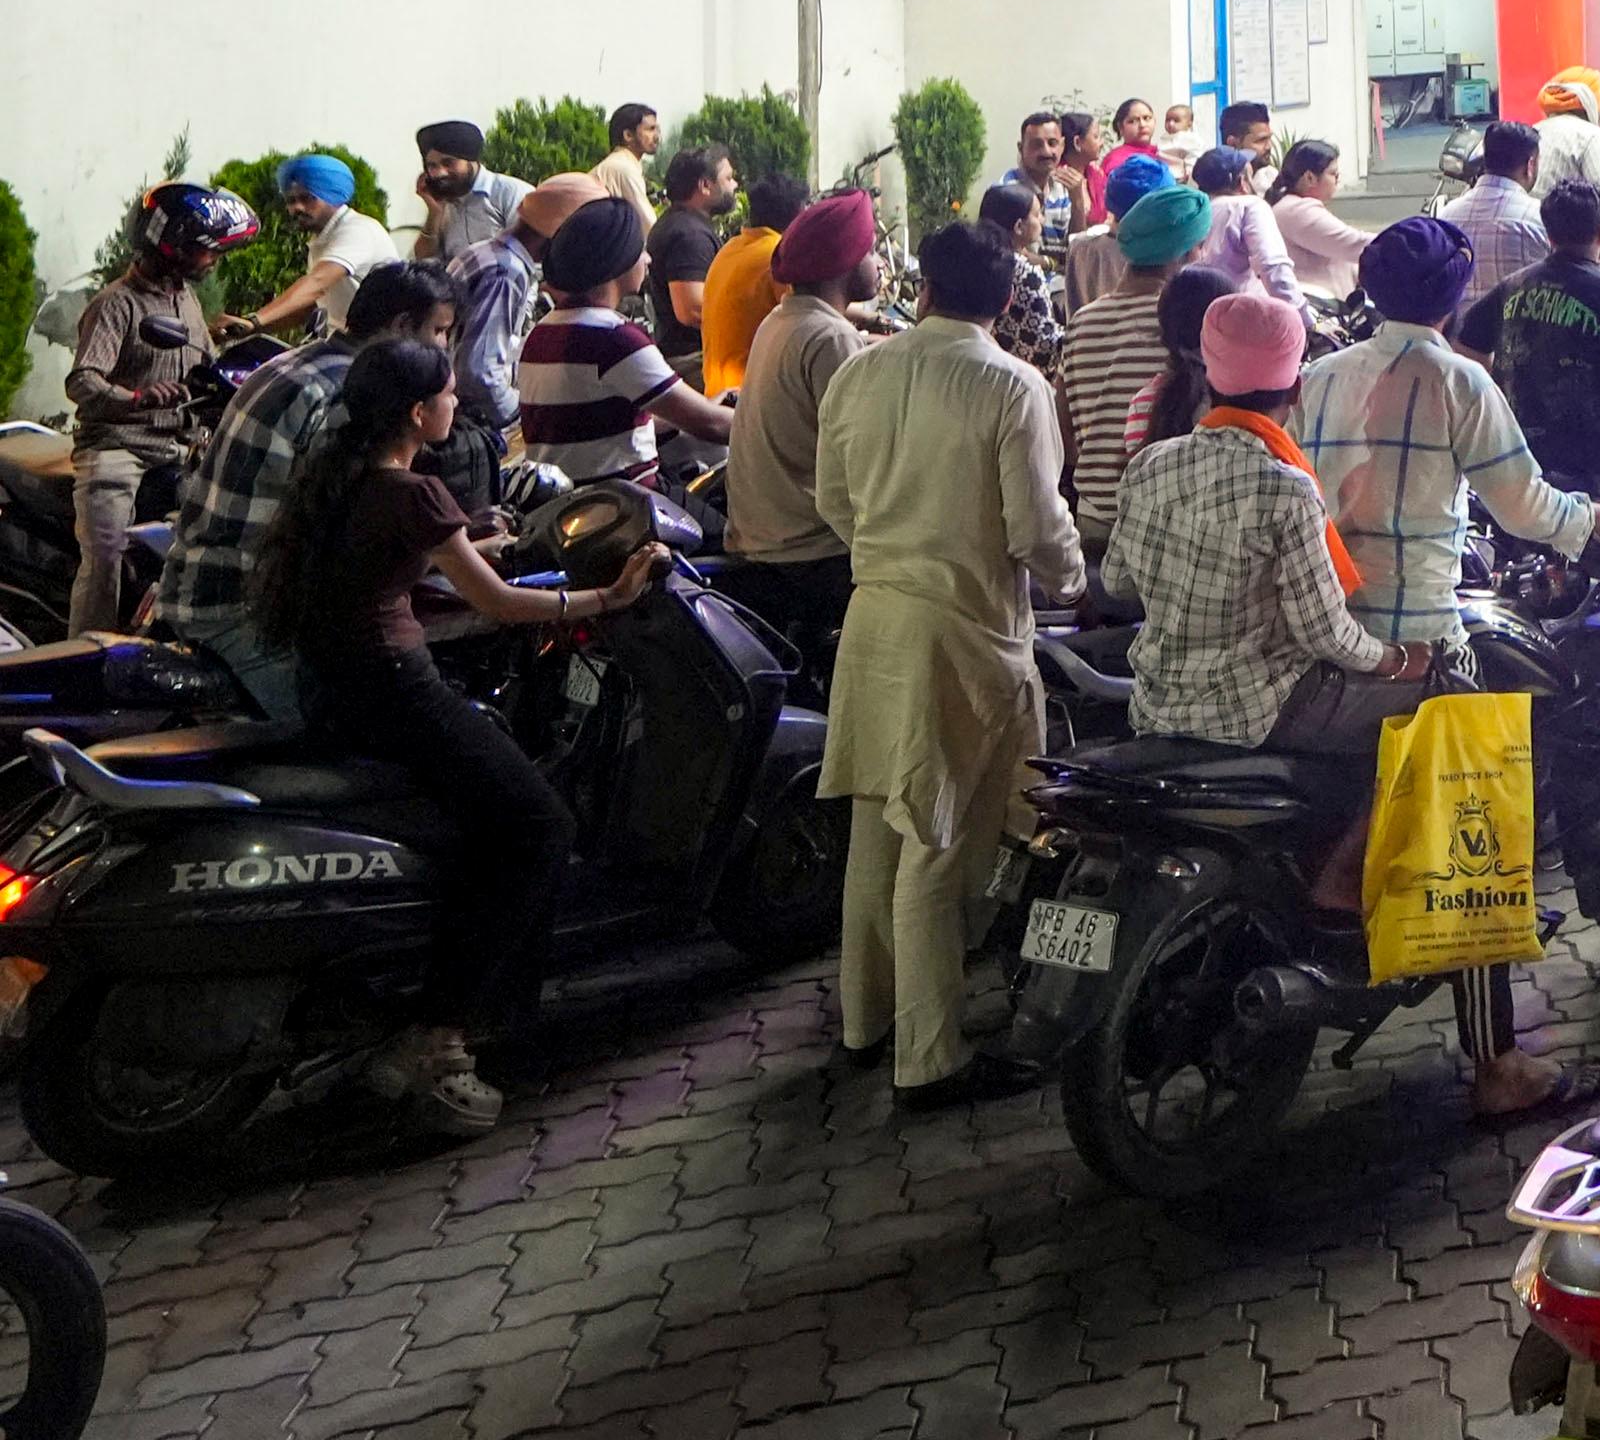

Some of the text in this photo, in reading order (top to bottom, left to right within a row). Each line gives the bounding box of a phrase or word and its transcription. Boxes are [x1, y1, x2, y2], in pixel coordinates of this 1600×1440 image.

[168, 850, 403, 893] HONDA
[1424, 886, 1528, 912] Fashion
[1041, 906, 1099, 938] PB 46
[1034, 933, 1092, 967] S6402
